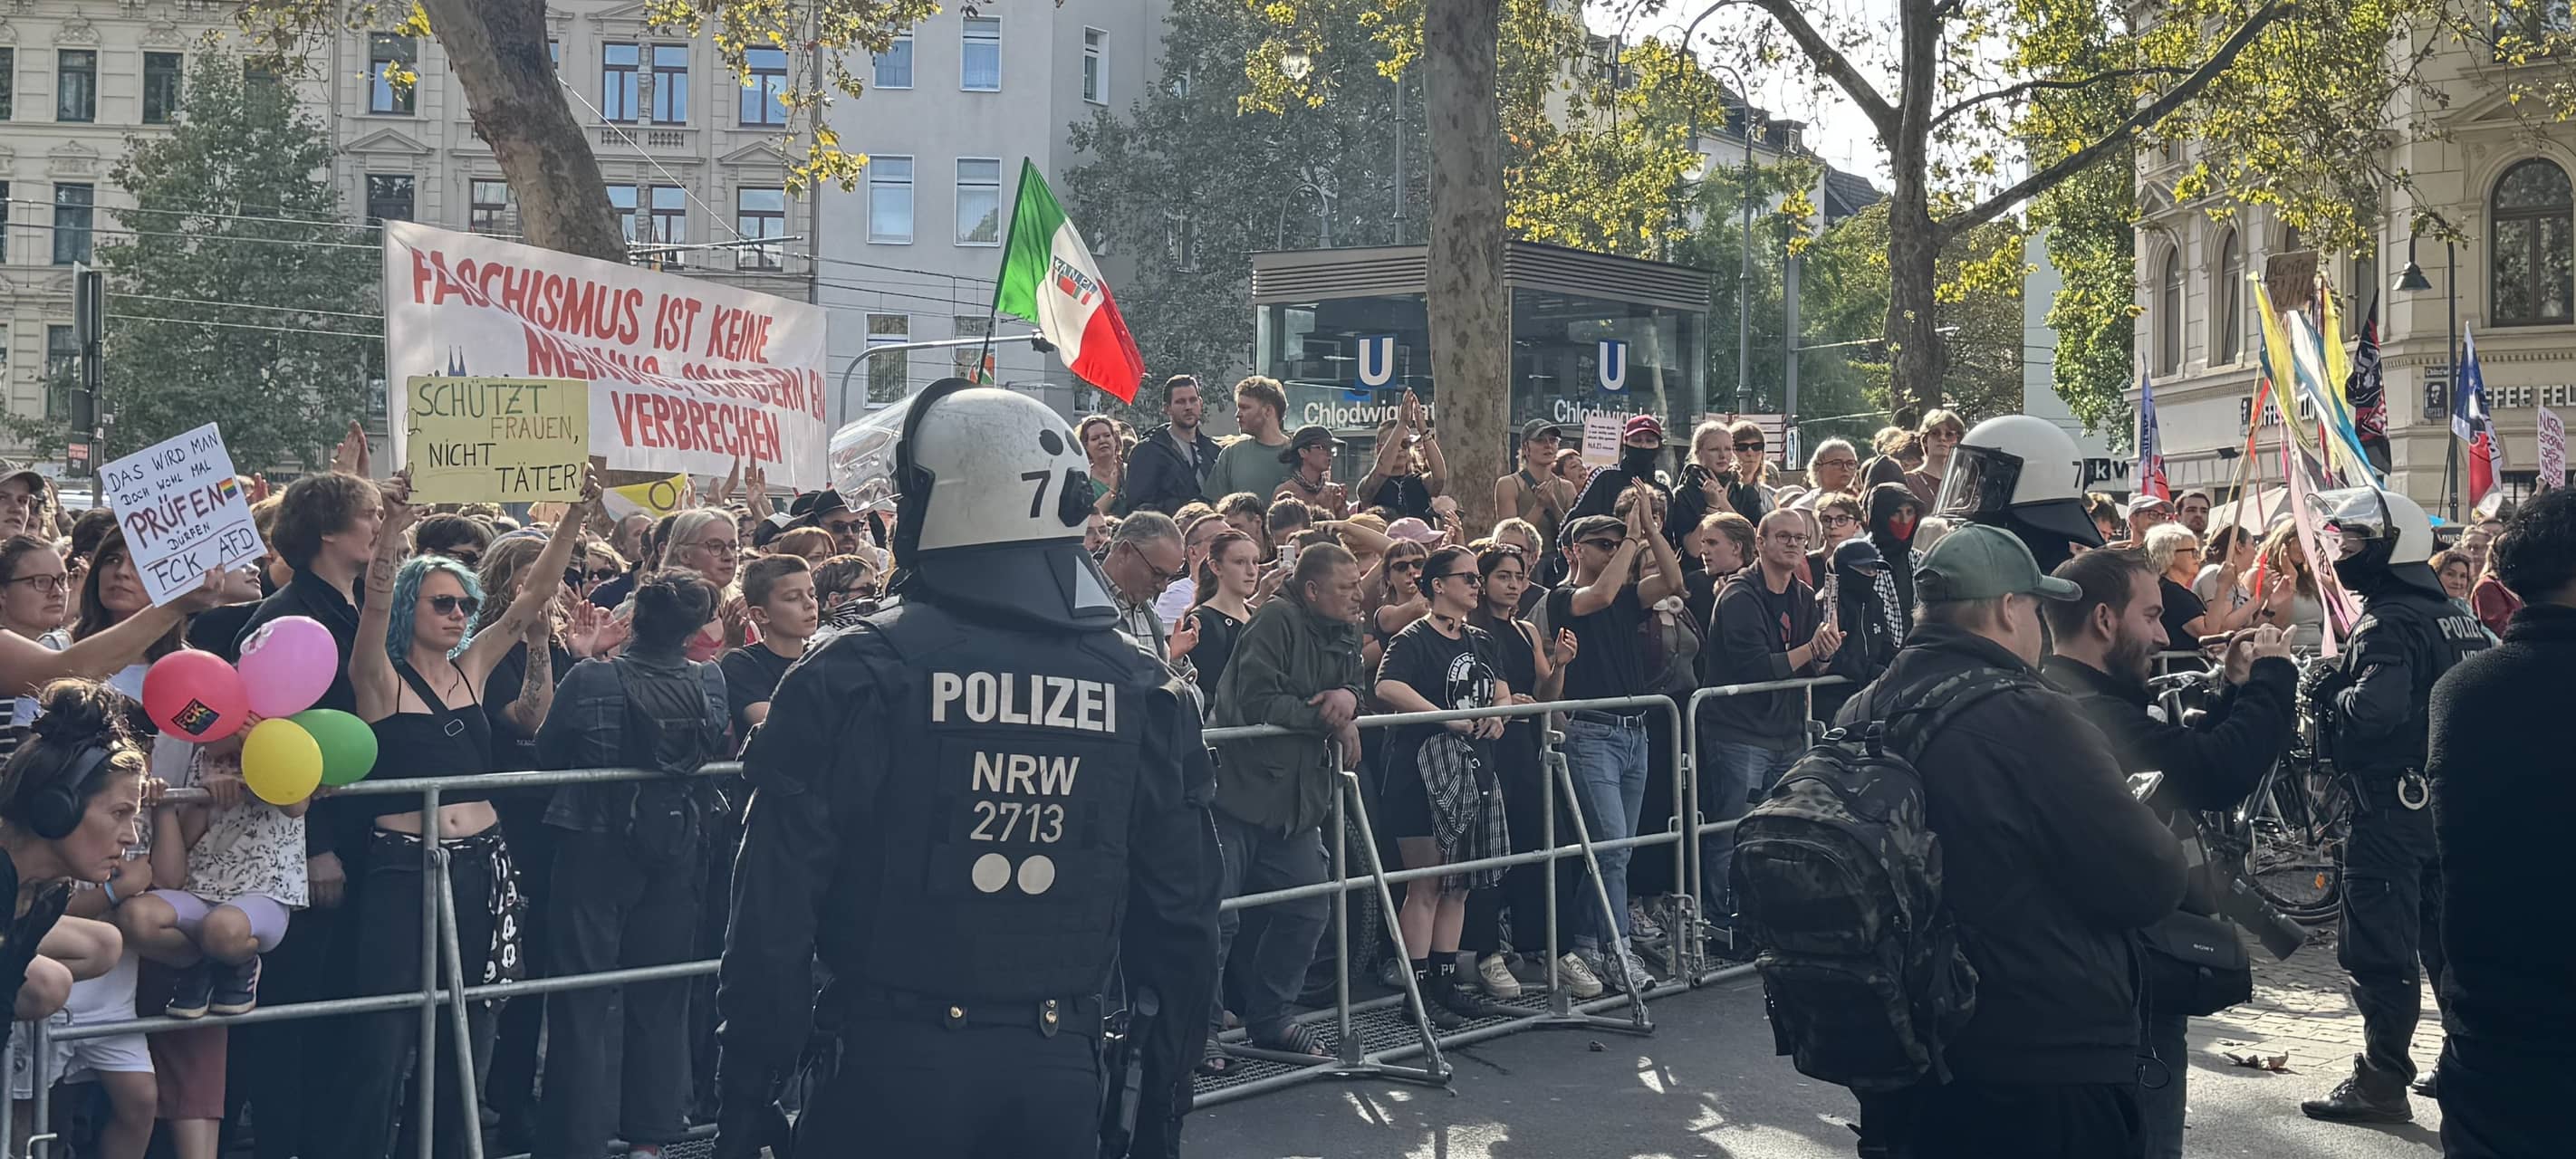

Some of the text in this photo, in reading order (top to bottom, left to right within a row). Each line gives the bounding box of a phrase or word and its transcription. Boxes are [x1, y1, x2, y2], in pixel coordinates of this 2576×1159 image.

[410, 246, 773, 364] FASCHISMUS IST KEINE
[1360, 338, 1393, 386] U
[1600, 341, 1626, 390] U
[417, 379, 547, 418] SCHÜTZT
[490, 417, 580, 445] FRAUEN,
[611, 390, 783, 464] VERBRECHEN
[108, 431, 219, 493] DAS WIRD MAN
[120, 460, 212, 506] DOCH WOHL MAL
[2071, 460, 2083, 489] 7
[124, 482, 226, 550] PRÜFEN
[1021, 470, 1052, 519] 7
[147, 527, 255, 590] FCK AFD
[167, 522, 211, 551] DÜRFEN
[932, 671, 1117, 733] POLIZEI
[971, 751, 1081, 796] NRW
[970, 800, 1065, 844] 2713
